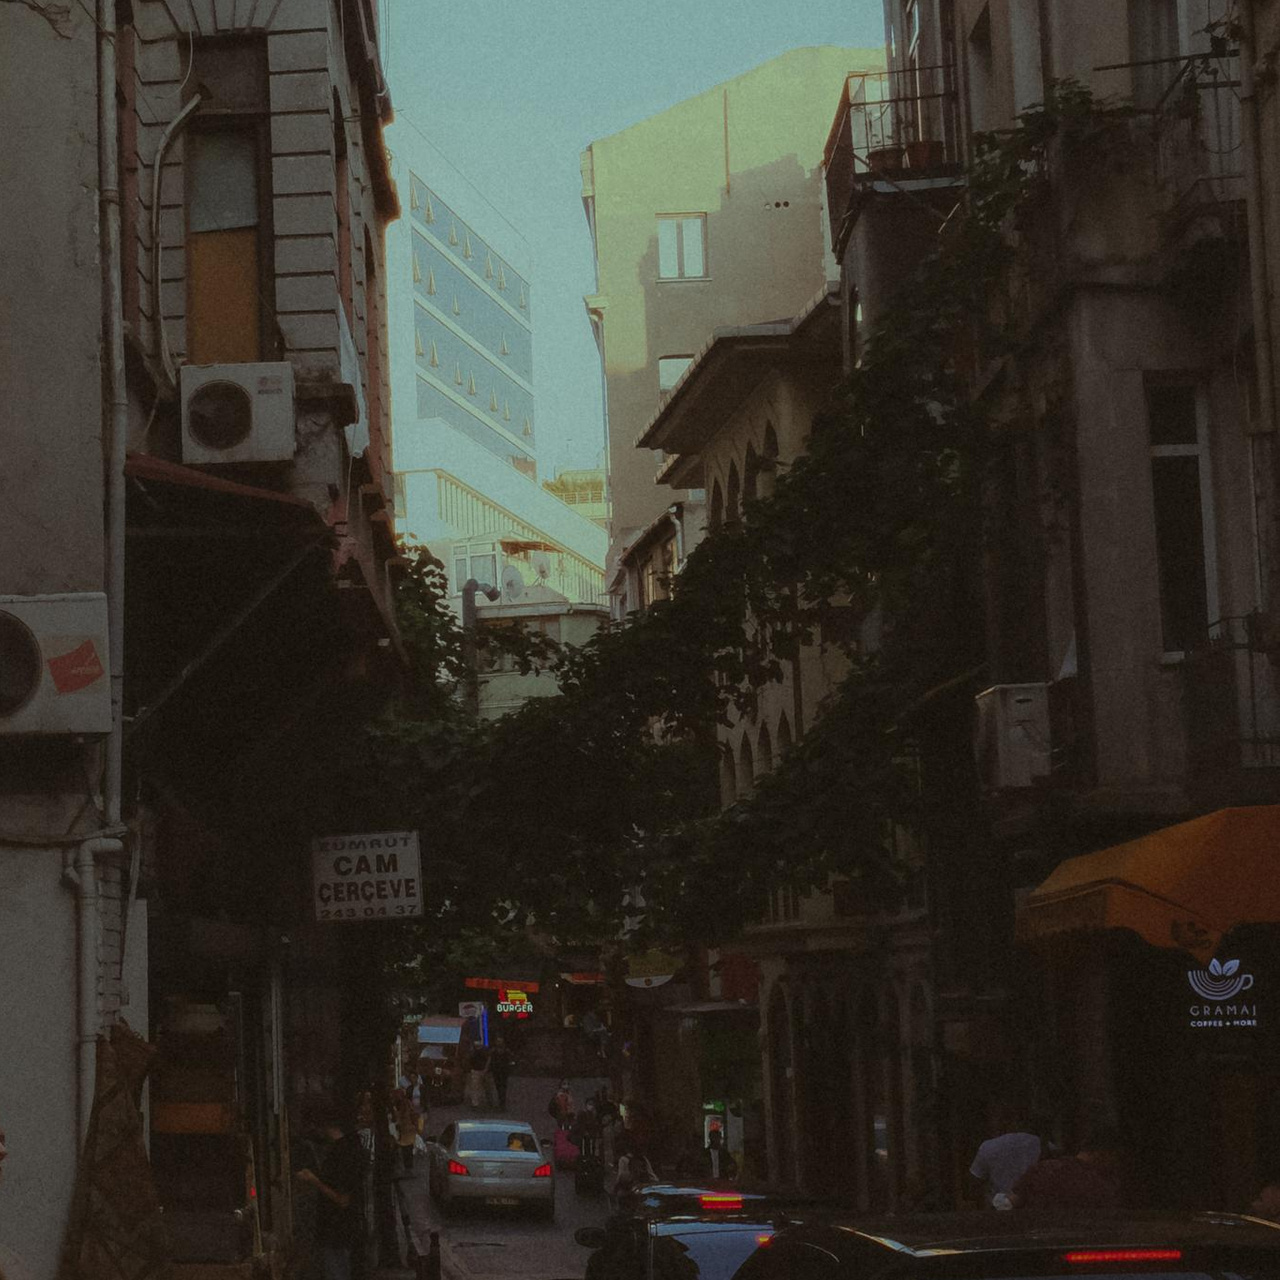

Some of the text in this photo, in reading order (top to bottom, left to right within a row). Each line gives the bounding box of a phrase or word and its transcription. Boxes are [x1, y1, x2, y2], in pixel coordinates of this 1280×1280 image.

[333, 853, 398, 876] CAM
[319, 878, 417, 906] ÇERÇEVE
[394, 904, 417, 915] 37
[496, 1003, 533, 1013] BURGER
